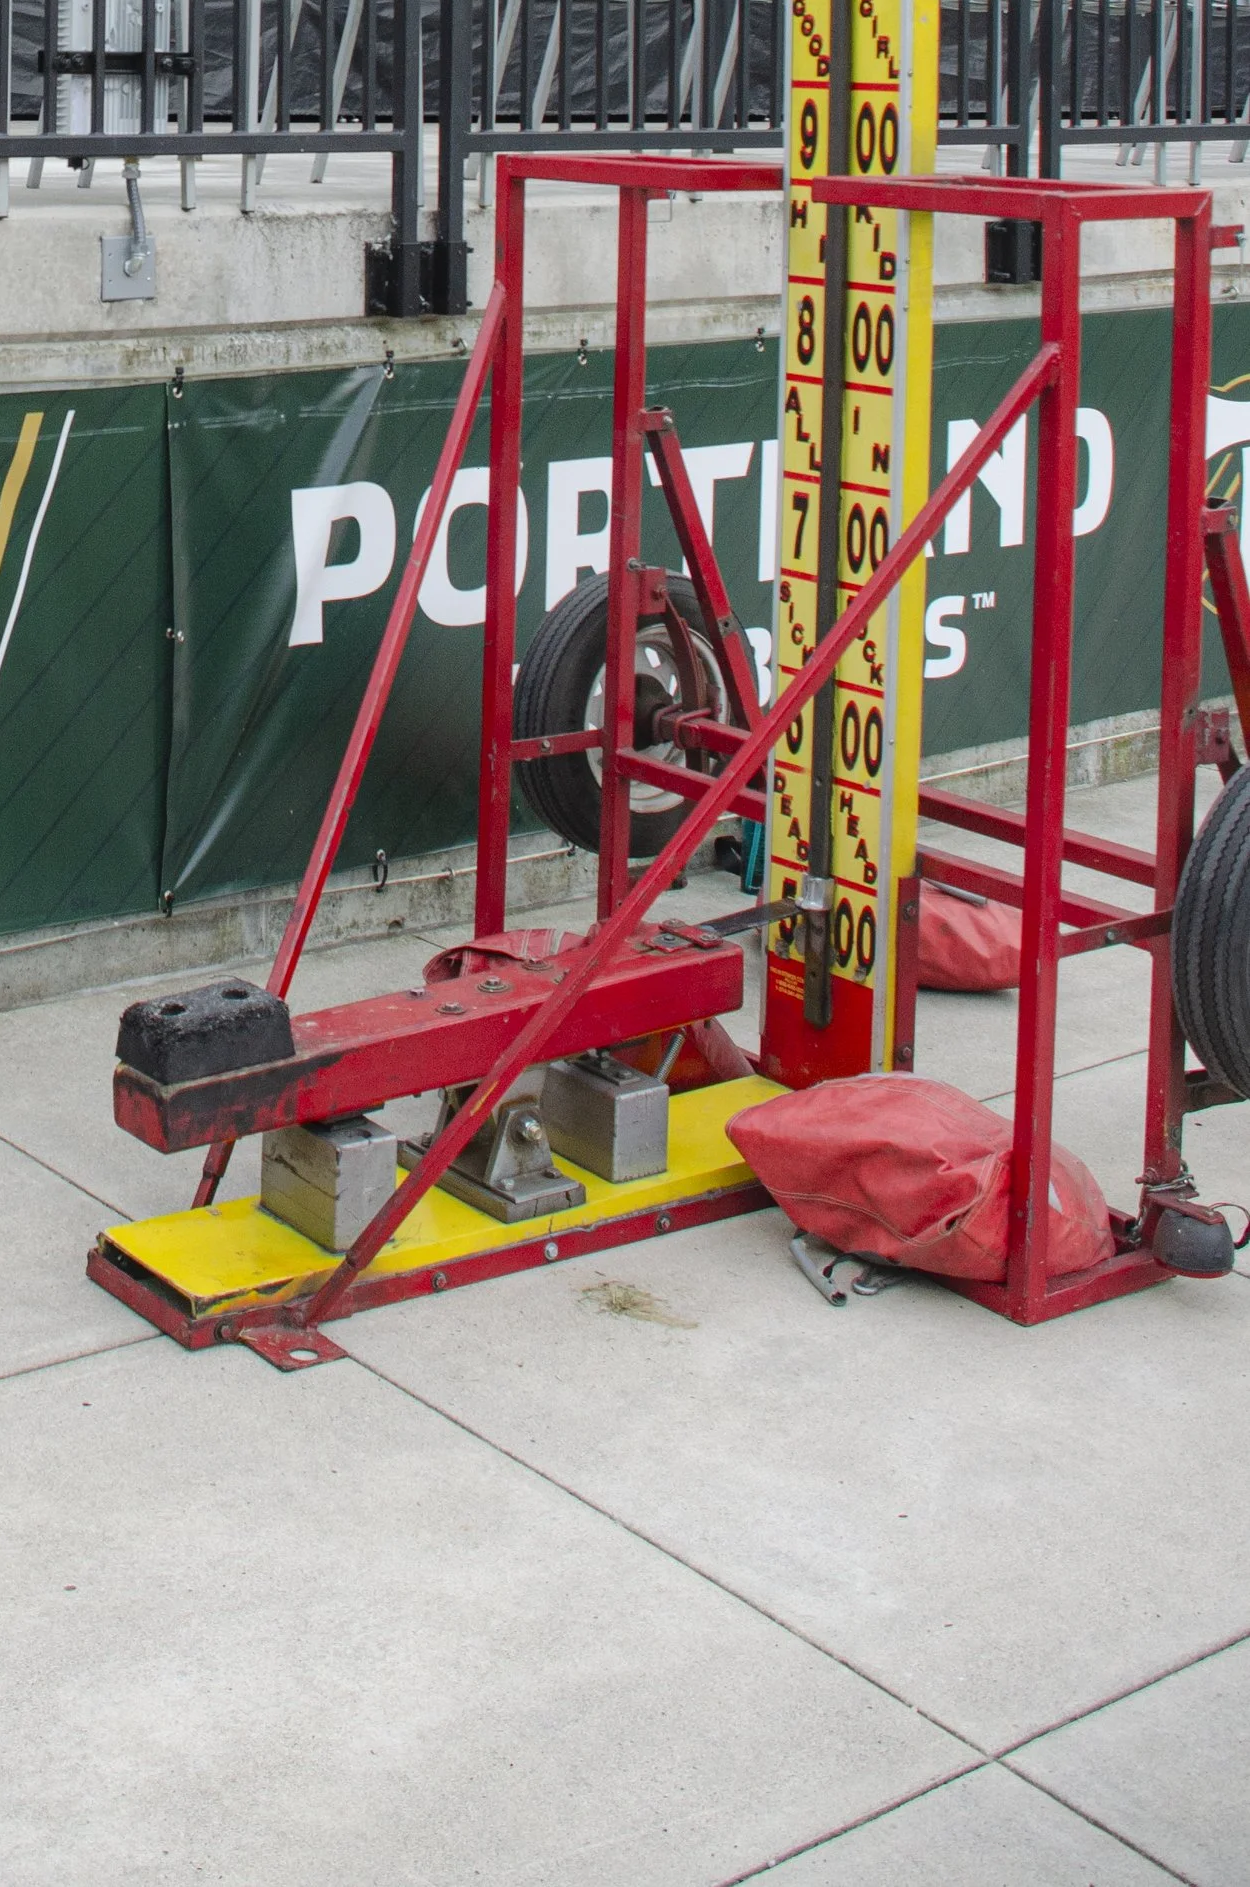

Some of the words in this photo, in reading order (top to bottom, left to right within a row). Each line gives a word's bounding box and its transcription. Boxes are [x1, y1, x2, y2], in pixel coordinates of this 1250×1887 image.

[800, 98, 818, 169] 9
[856, 101, 899, 175] 00
[791, 200, 827, 263] HI
[855, 205, 896, 281] KID
[797, 295, 815, 365] 8
[852, 301, 895, 376] 00
[785, 386, 822, 471] ALL
[853, 406, 890, 473] IN
[793, 491, 810, 560] 7
[847, 503, 889, 574] 00
[847, 595, 884, 686] CK
[841, 700, 883, 778] 00
[774, 771, 809, 862] DEAD
[839, 791, 878, 885] HEAD
[834, 897, 877, 976] 00
